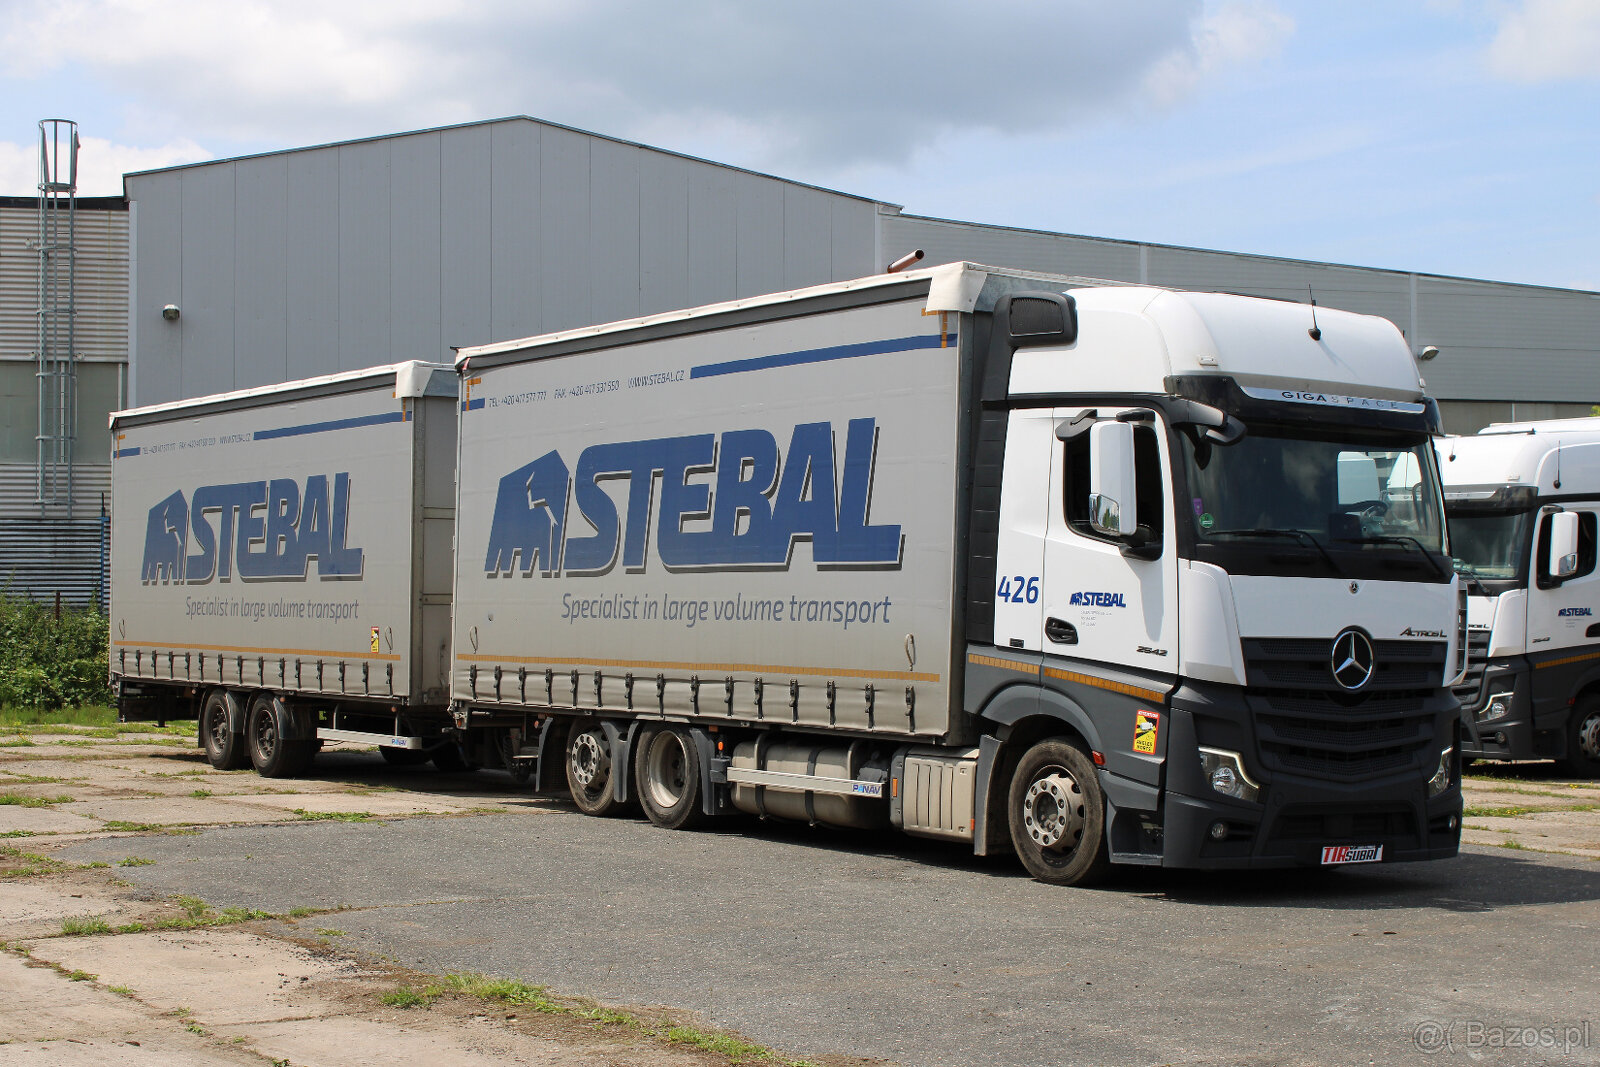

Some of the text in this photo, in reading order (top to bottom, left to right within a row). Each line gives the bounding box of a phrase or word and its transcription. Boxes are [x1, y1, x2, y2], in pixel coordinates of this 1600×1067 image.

[998, 576, 1040, 604] 426
[185, 596, 360, 624] Specialist in large volume transport
[560, 592, 892, 630] Specialist in large volume transport
